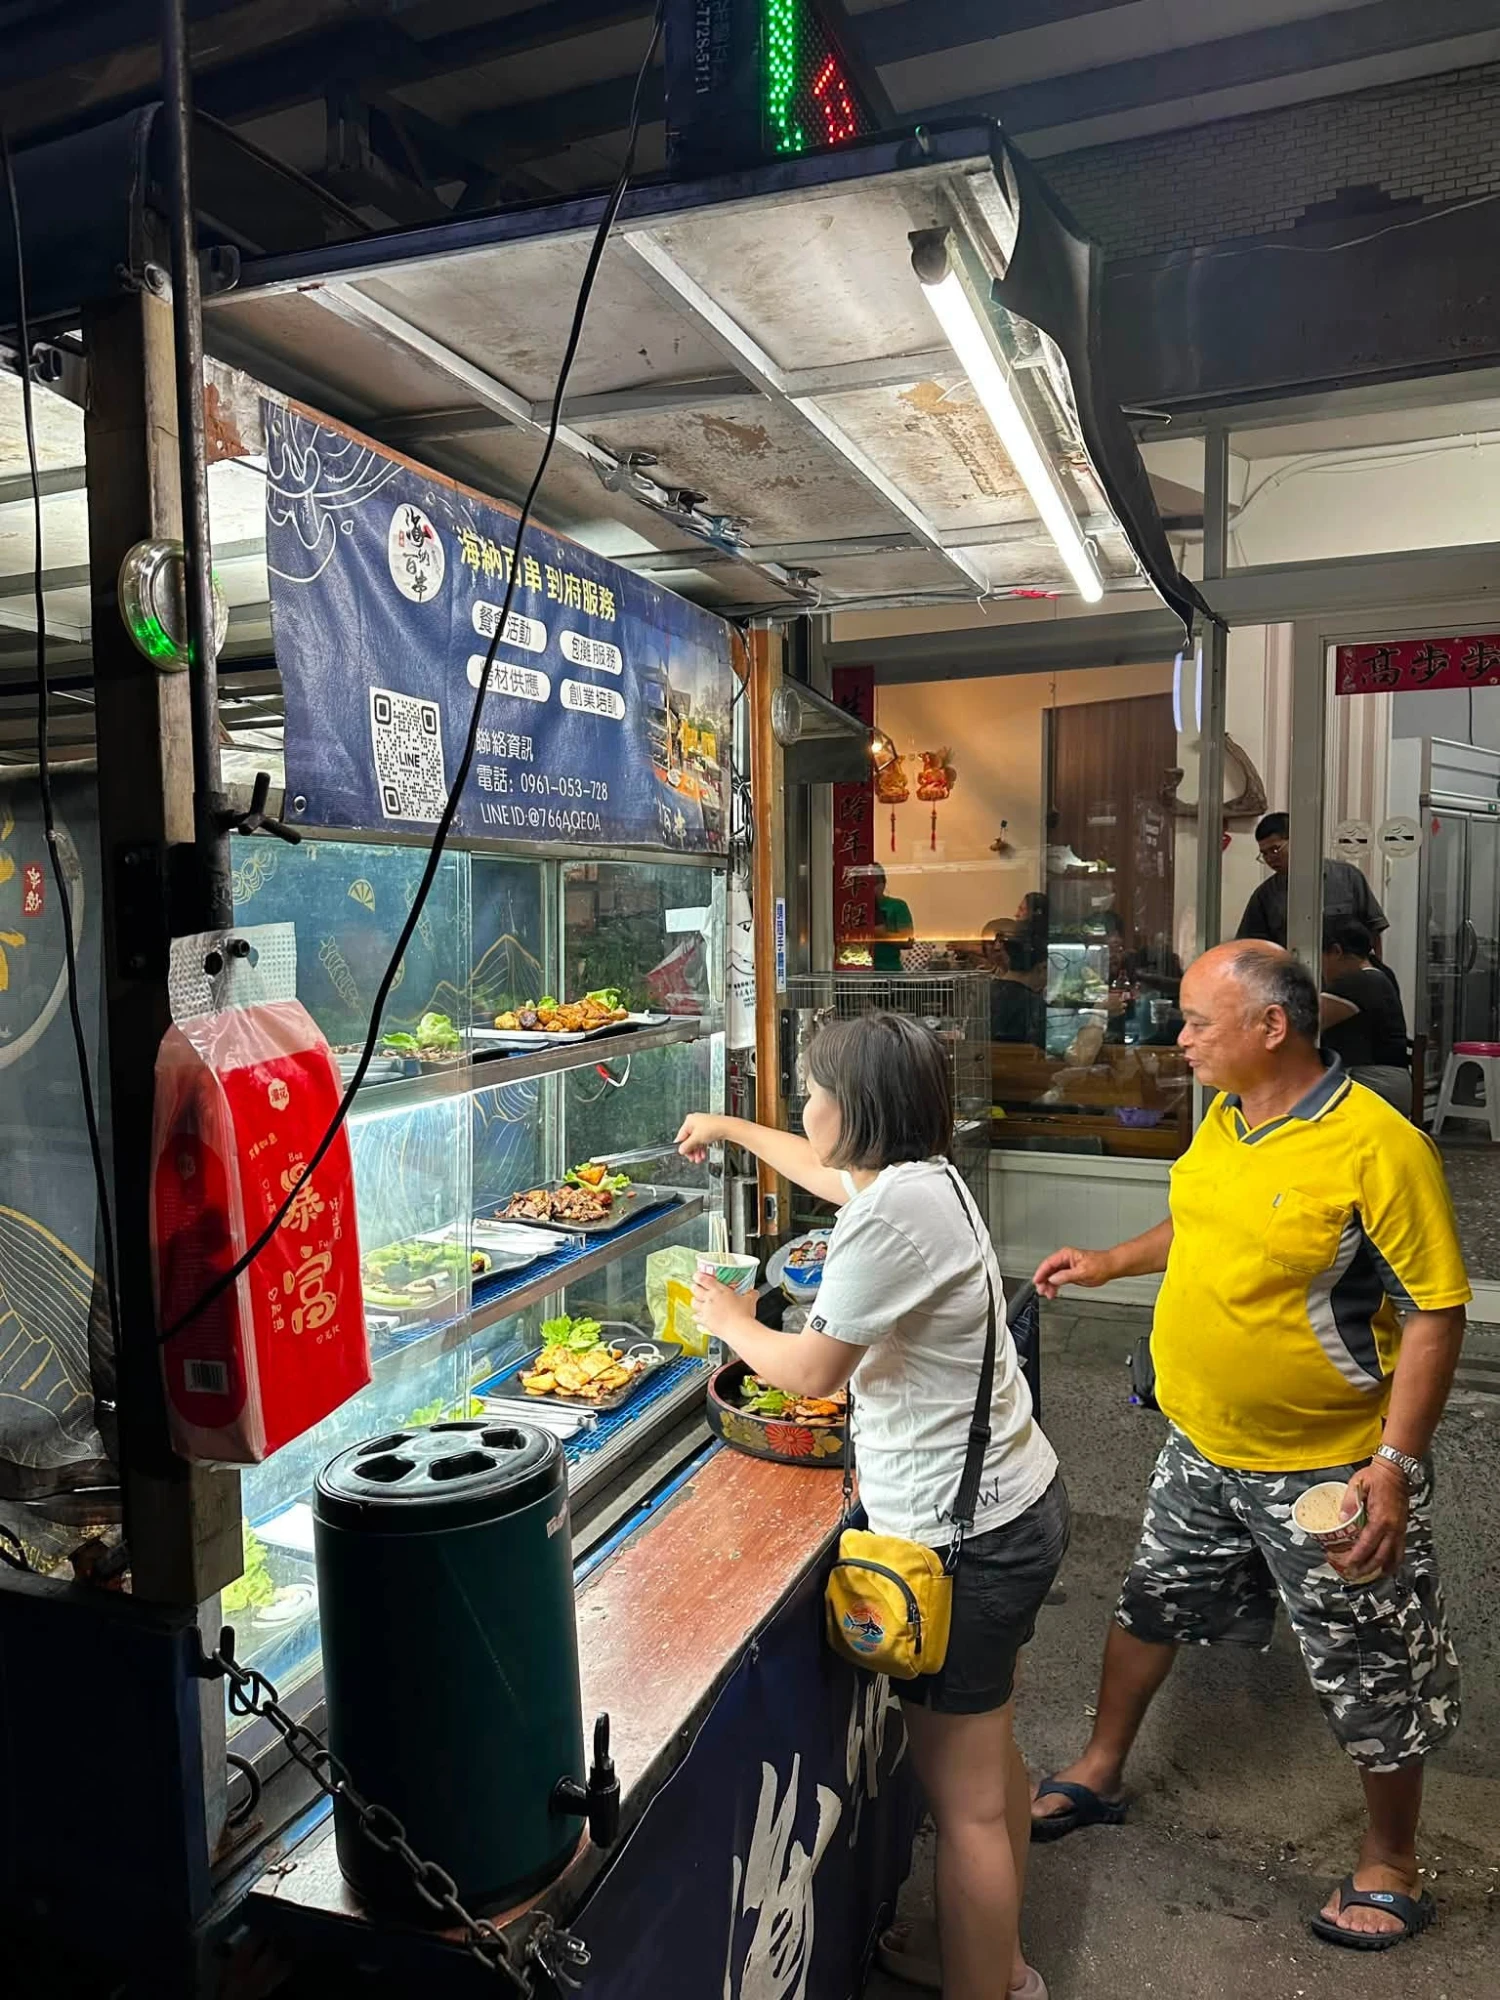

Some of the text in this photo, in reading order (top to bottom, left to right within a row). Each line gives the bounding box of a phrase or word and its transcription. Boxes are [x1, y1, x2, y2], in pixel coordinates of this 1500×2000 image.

[545, 564, 616, 623] 到府服務
[399, 751, 420, 768] LINE
[475, 727, 534, 763] 聯絡資訊
[520, 772, 609, 801] 0961-053-728
